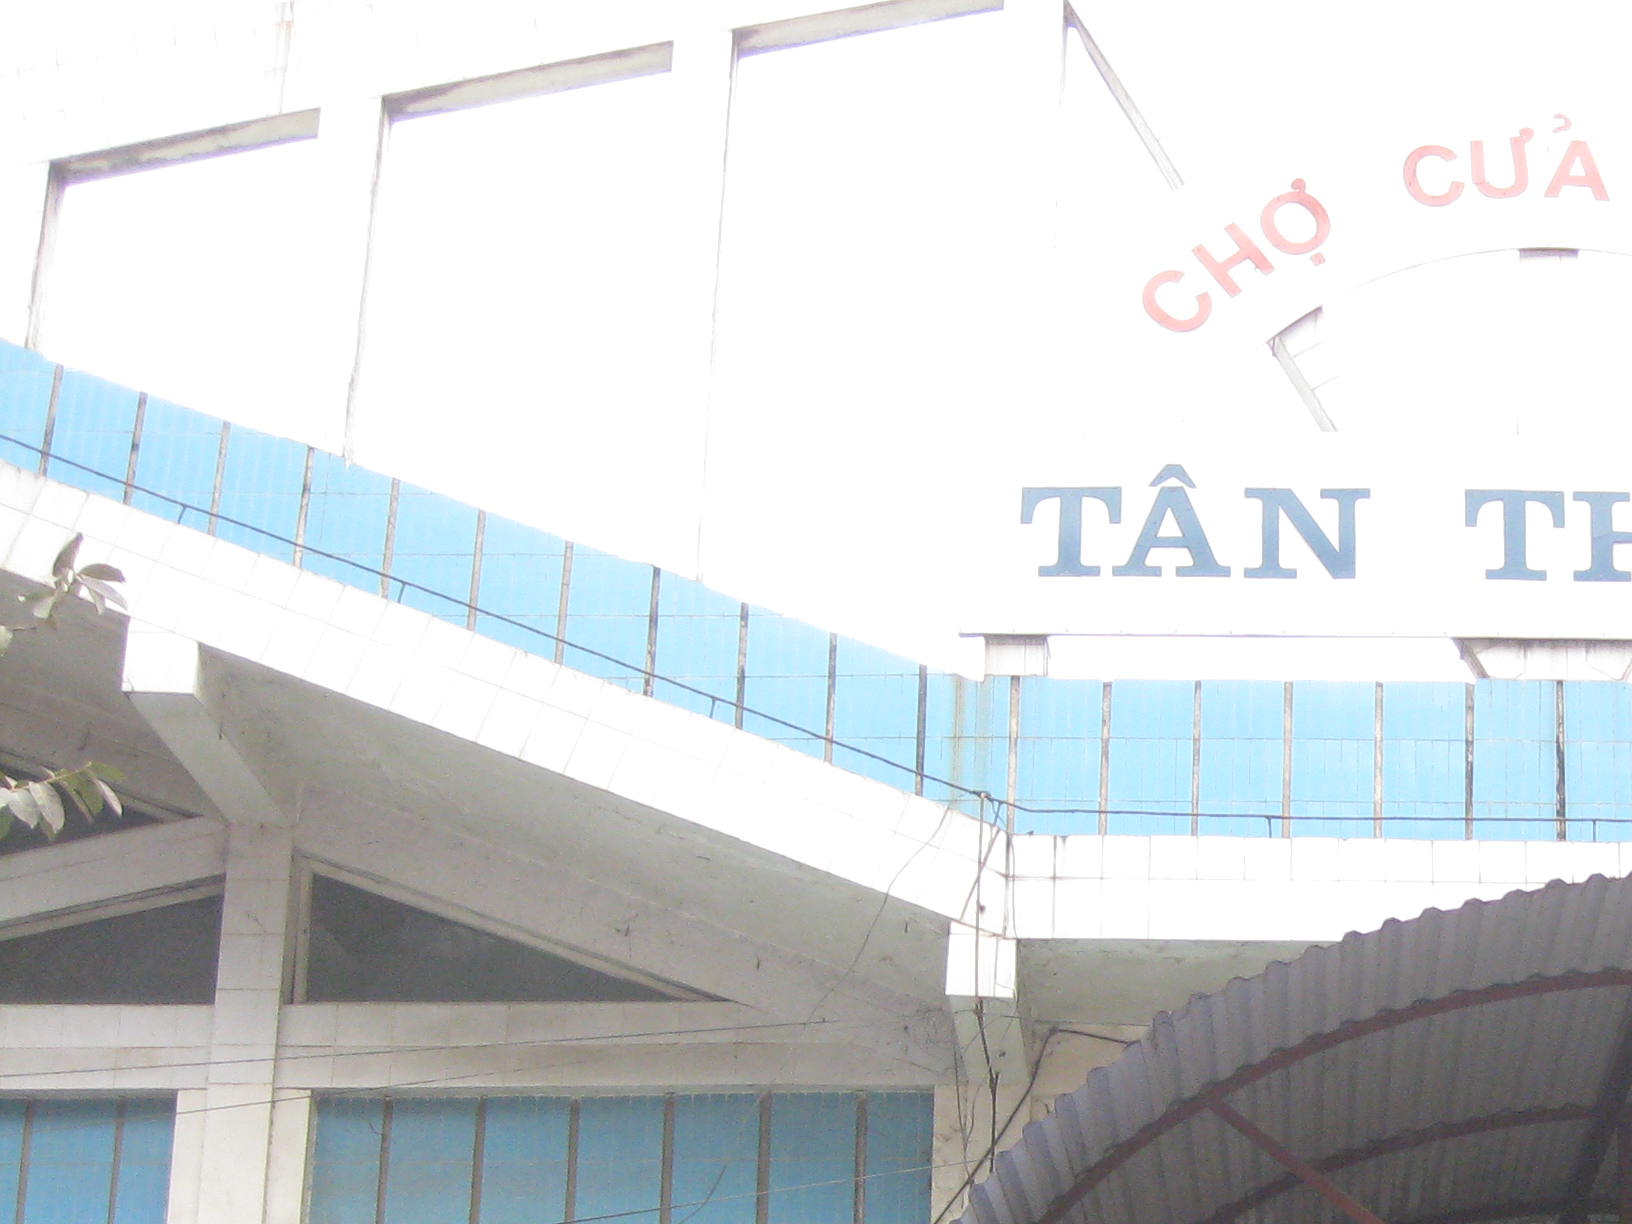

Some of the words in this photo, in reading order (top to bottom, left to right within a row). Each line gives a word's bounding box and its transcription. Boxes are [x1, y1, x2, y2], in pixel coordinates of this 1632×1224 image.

[1142, 178, 1331, 334] CHỢ
[1402, 114, 1609, 207] CỬA
[1020, 464, 1371, 580] TÂN
